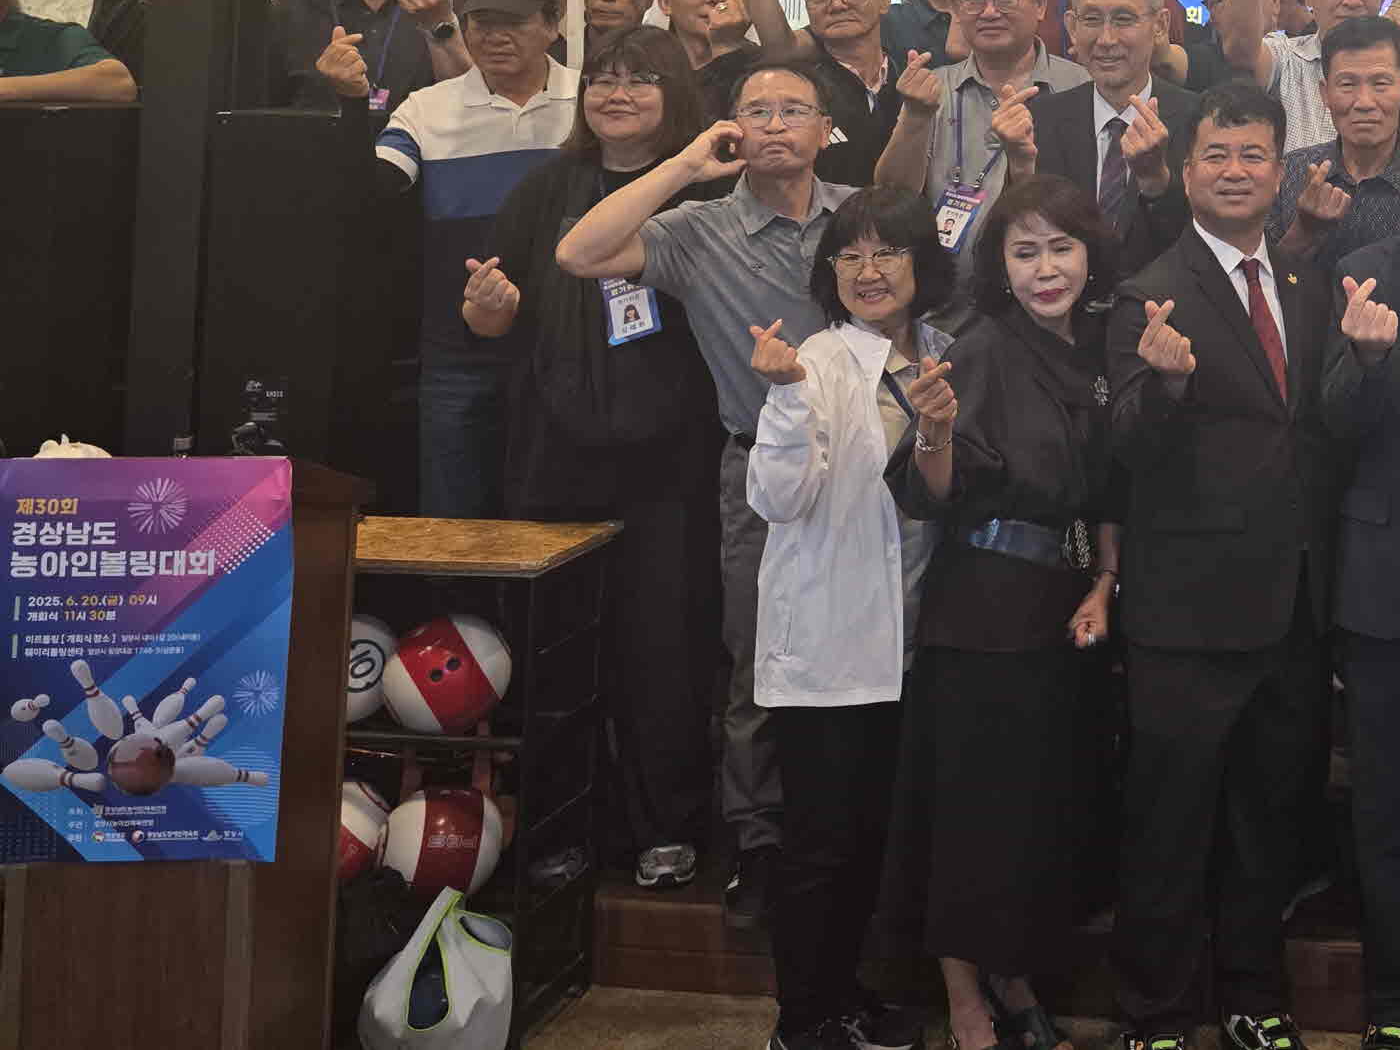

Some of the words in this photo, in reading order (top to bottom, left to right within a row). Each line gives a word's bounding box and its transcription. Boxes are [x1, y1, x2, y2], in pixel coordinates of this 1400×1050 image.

[16, 498, 79, 515] 제30회
[12, 521, 117, 546] 경상남도
[10, 550, 216, 578] 농아인볼링대회
[28, 596, 63, 607] 2025.
[129, 594, 157, 606] 09시
[27, 610, 58, 622] 개회식
[64, 610, 86, 621] 11시
[89, 610, 116, 621] 30분
